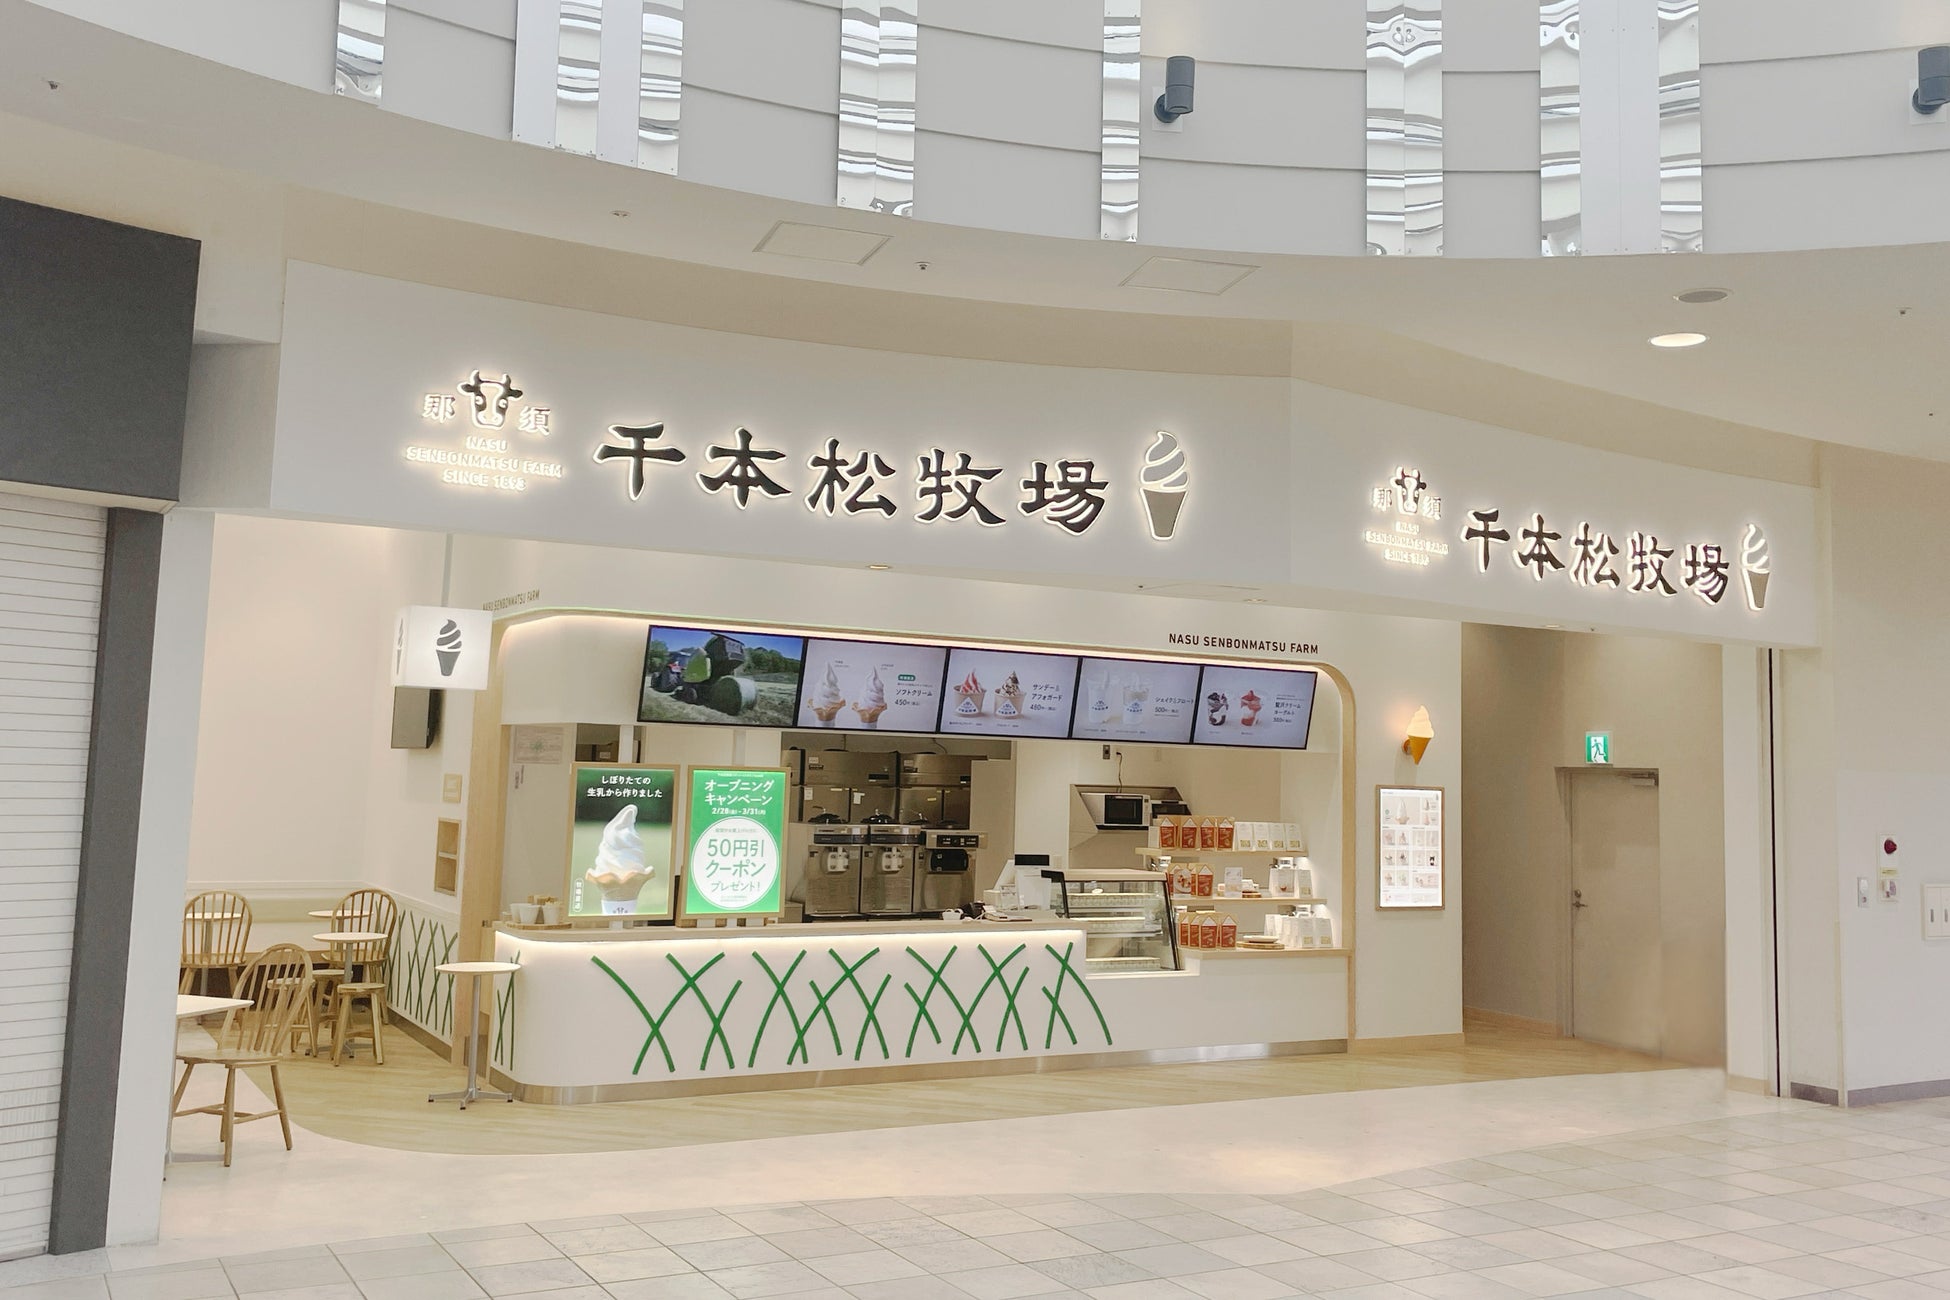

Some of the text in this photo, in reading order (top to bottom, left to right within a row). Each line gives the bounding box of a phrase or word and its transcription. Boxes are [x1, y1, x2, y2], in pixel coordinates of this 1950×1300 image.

[421, 394, 550, 435] 那 須
[466, 436, 508, 453] NASU
[406, 446, 565, 479] SENBONMATSU FARM
[443, 469, 489, 488] SINCE
[593, 422, 1109, 536] 千本松牧場
[1460, 507, 1730, 606] 千本松牧場
[1169, 633, 1318, 654] NASU SENBONMATSU FARM
[602, 775, 651, 785] しぼりたての
[705, 779, 775, 792] オープニング
[587, 787, 663, 797] 生乳から作りました
[705, 793, 773, 806] キャンペーン
[707, 838, 764, 857] 50円引
[705, 859, 766, 878] クーポン
